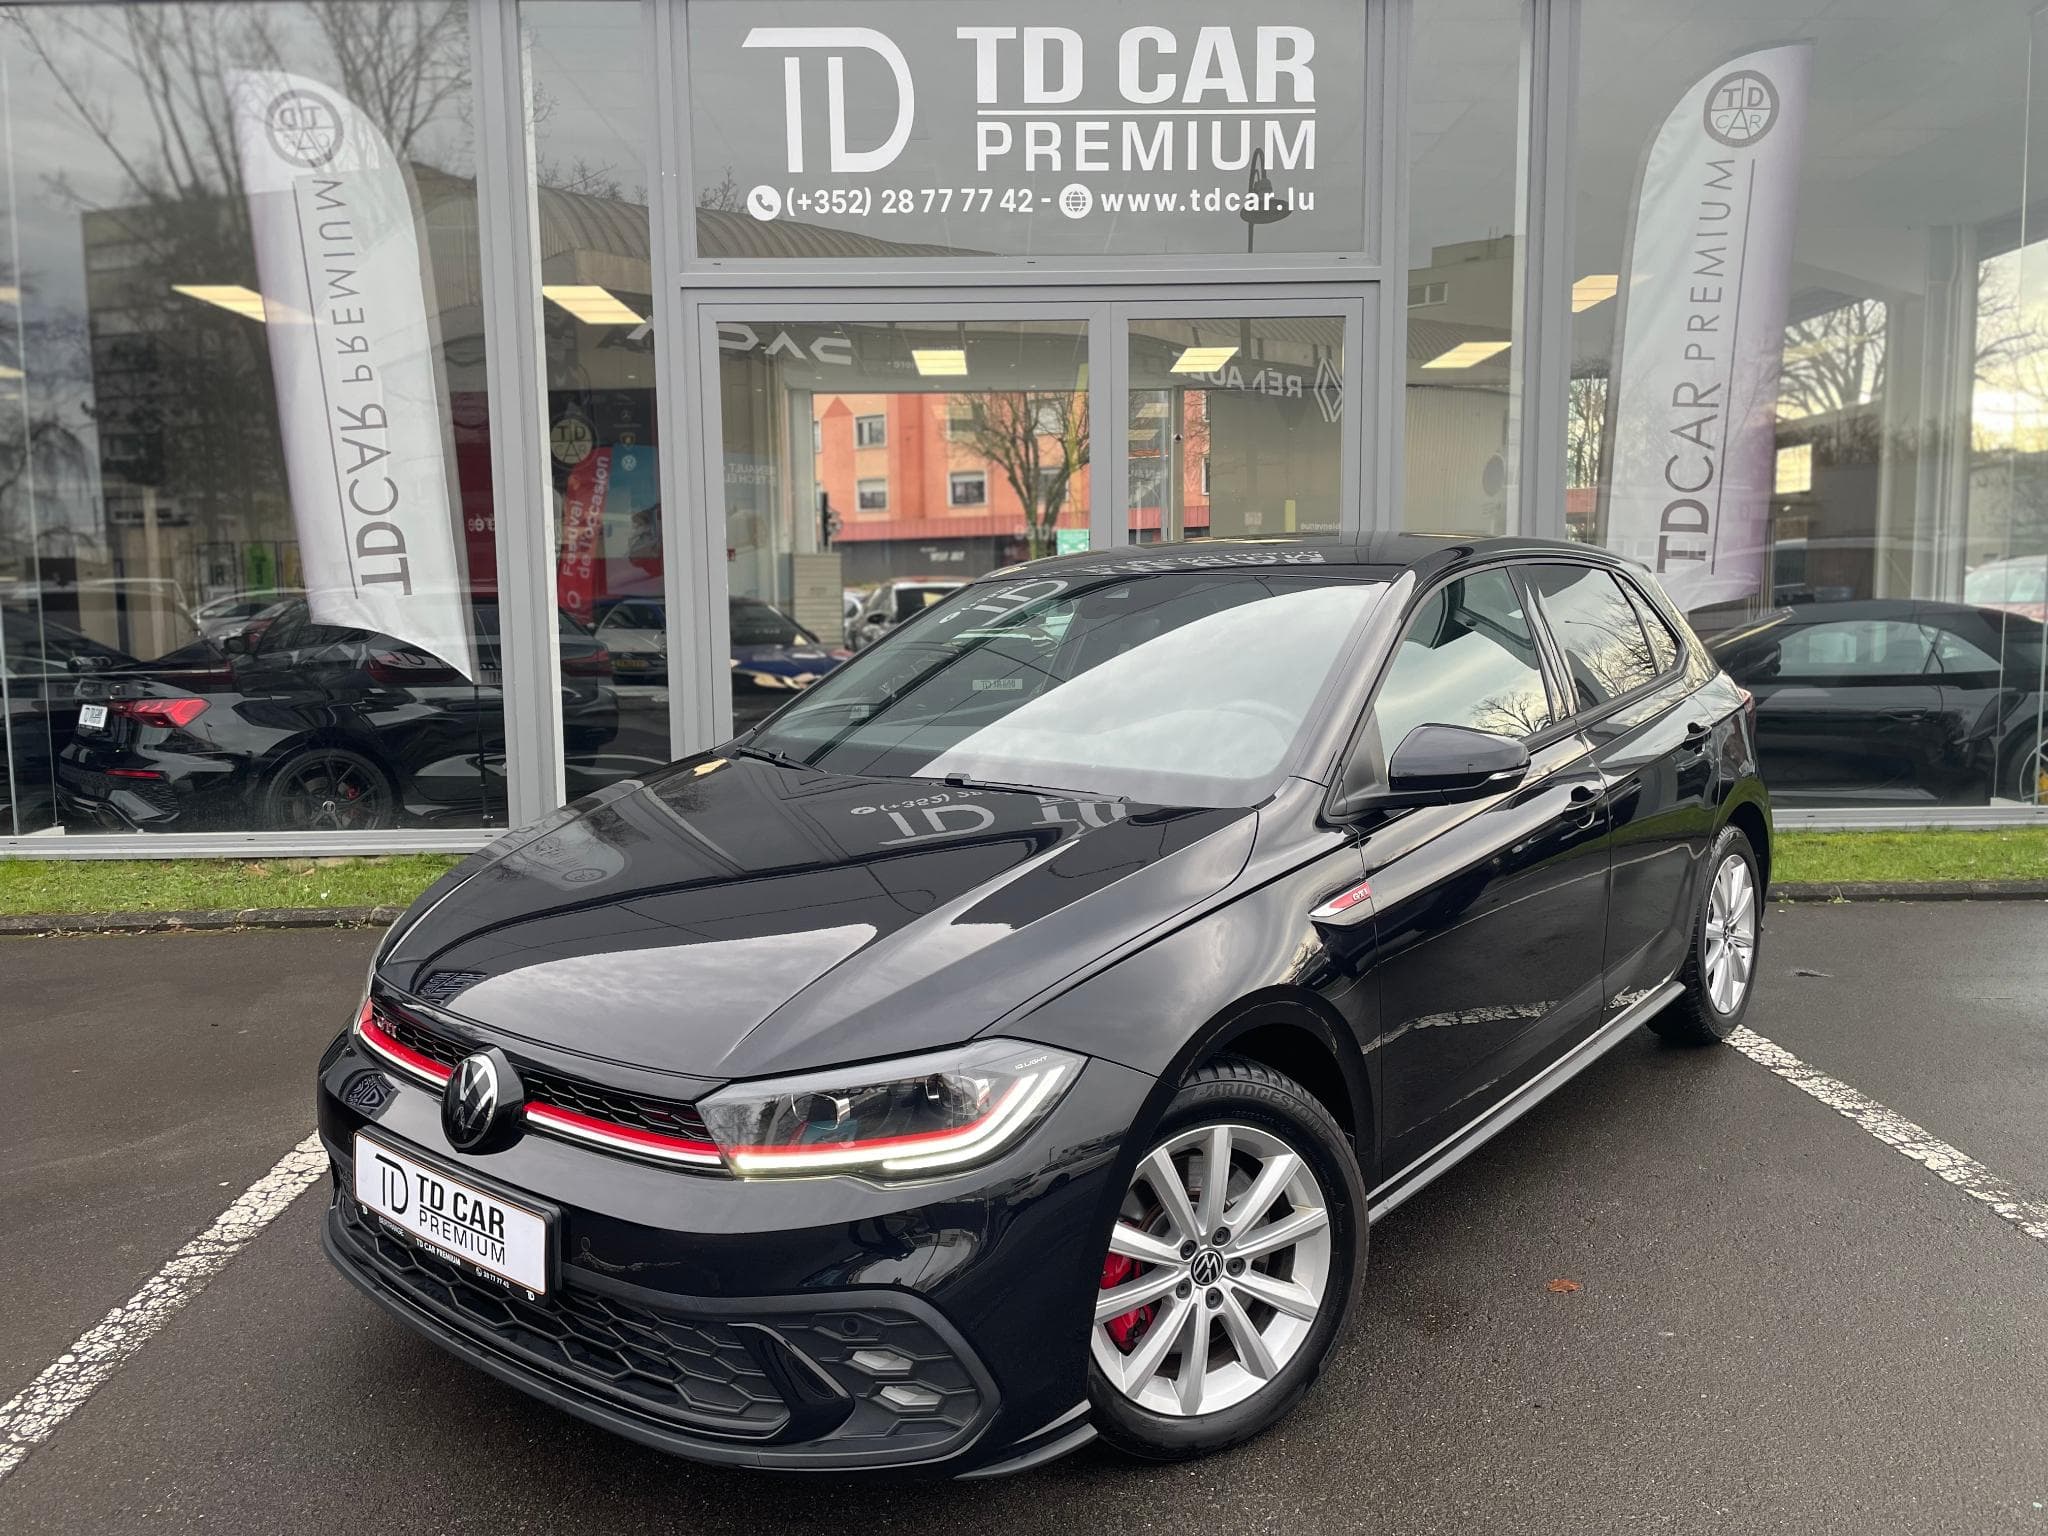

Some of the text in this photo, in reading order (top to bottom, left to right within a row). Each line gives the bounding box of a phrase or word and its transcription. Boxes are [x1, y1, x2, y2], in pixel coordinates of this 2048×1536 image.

[956, 25, 1316, 104] TD CAR
[741, 27, 914, 173] TD
[976, 119, 1316, 172] PREMIUM
[786, 186, 872, 216] (+352)
[881, 189, 915, 213] 28
[920, 188, 953, 213] 77
[961, 188, 994, 213] 77
[999, 188, 1033, 213] 42
[1101, 187, 1315, 212] www.tdcar.lu
[1684, 160, 1736, 361] PREMIUM
[416, 1173, 505, 1239] TD CAR
[416, 1238, 461, 1266] TD CAR PREMIUM
[420, 1210, 505, 1265] PREMIUM
